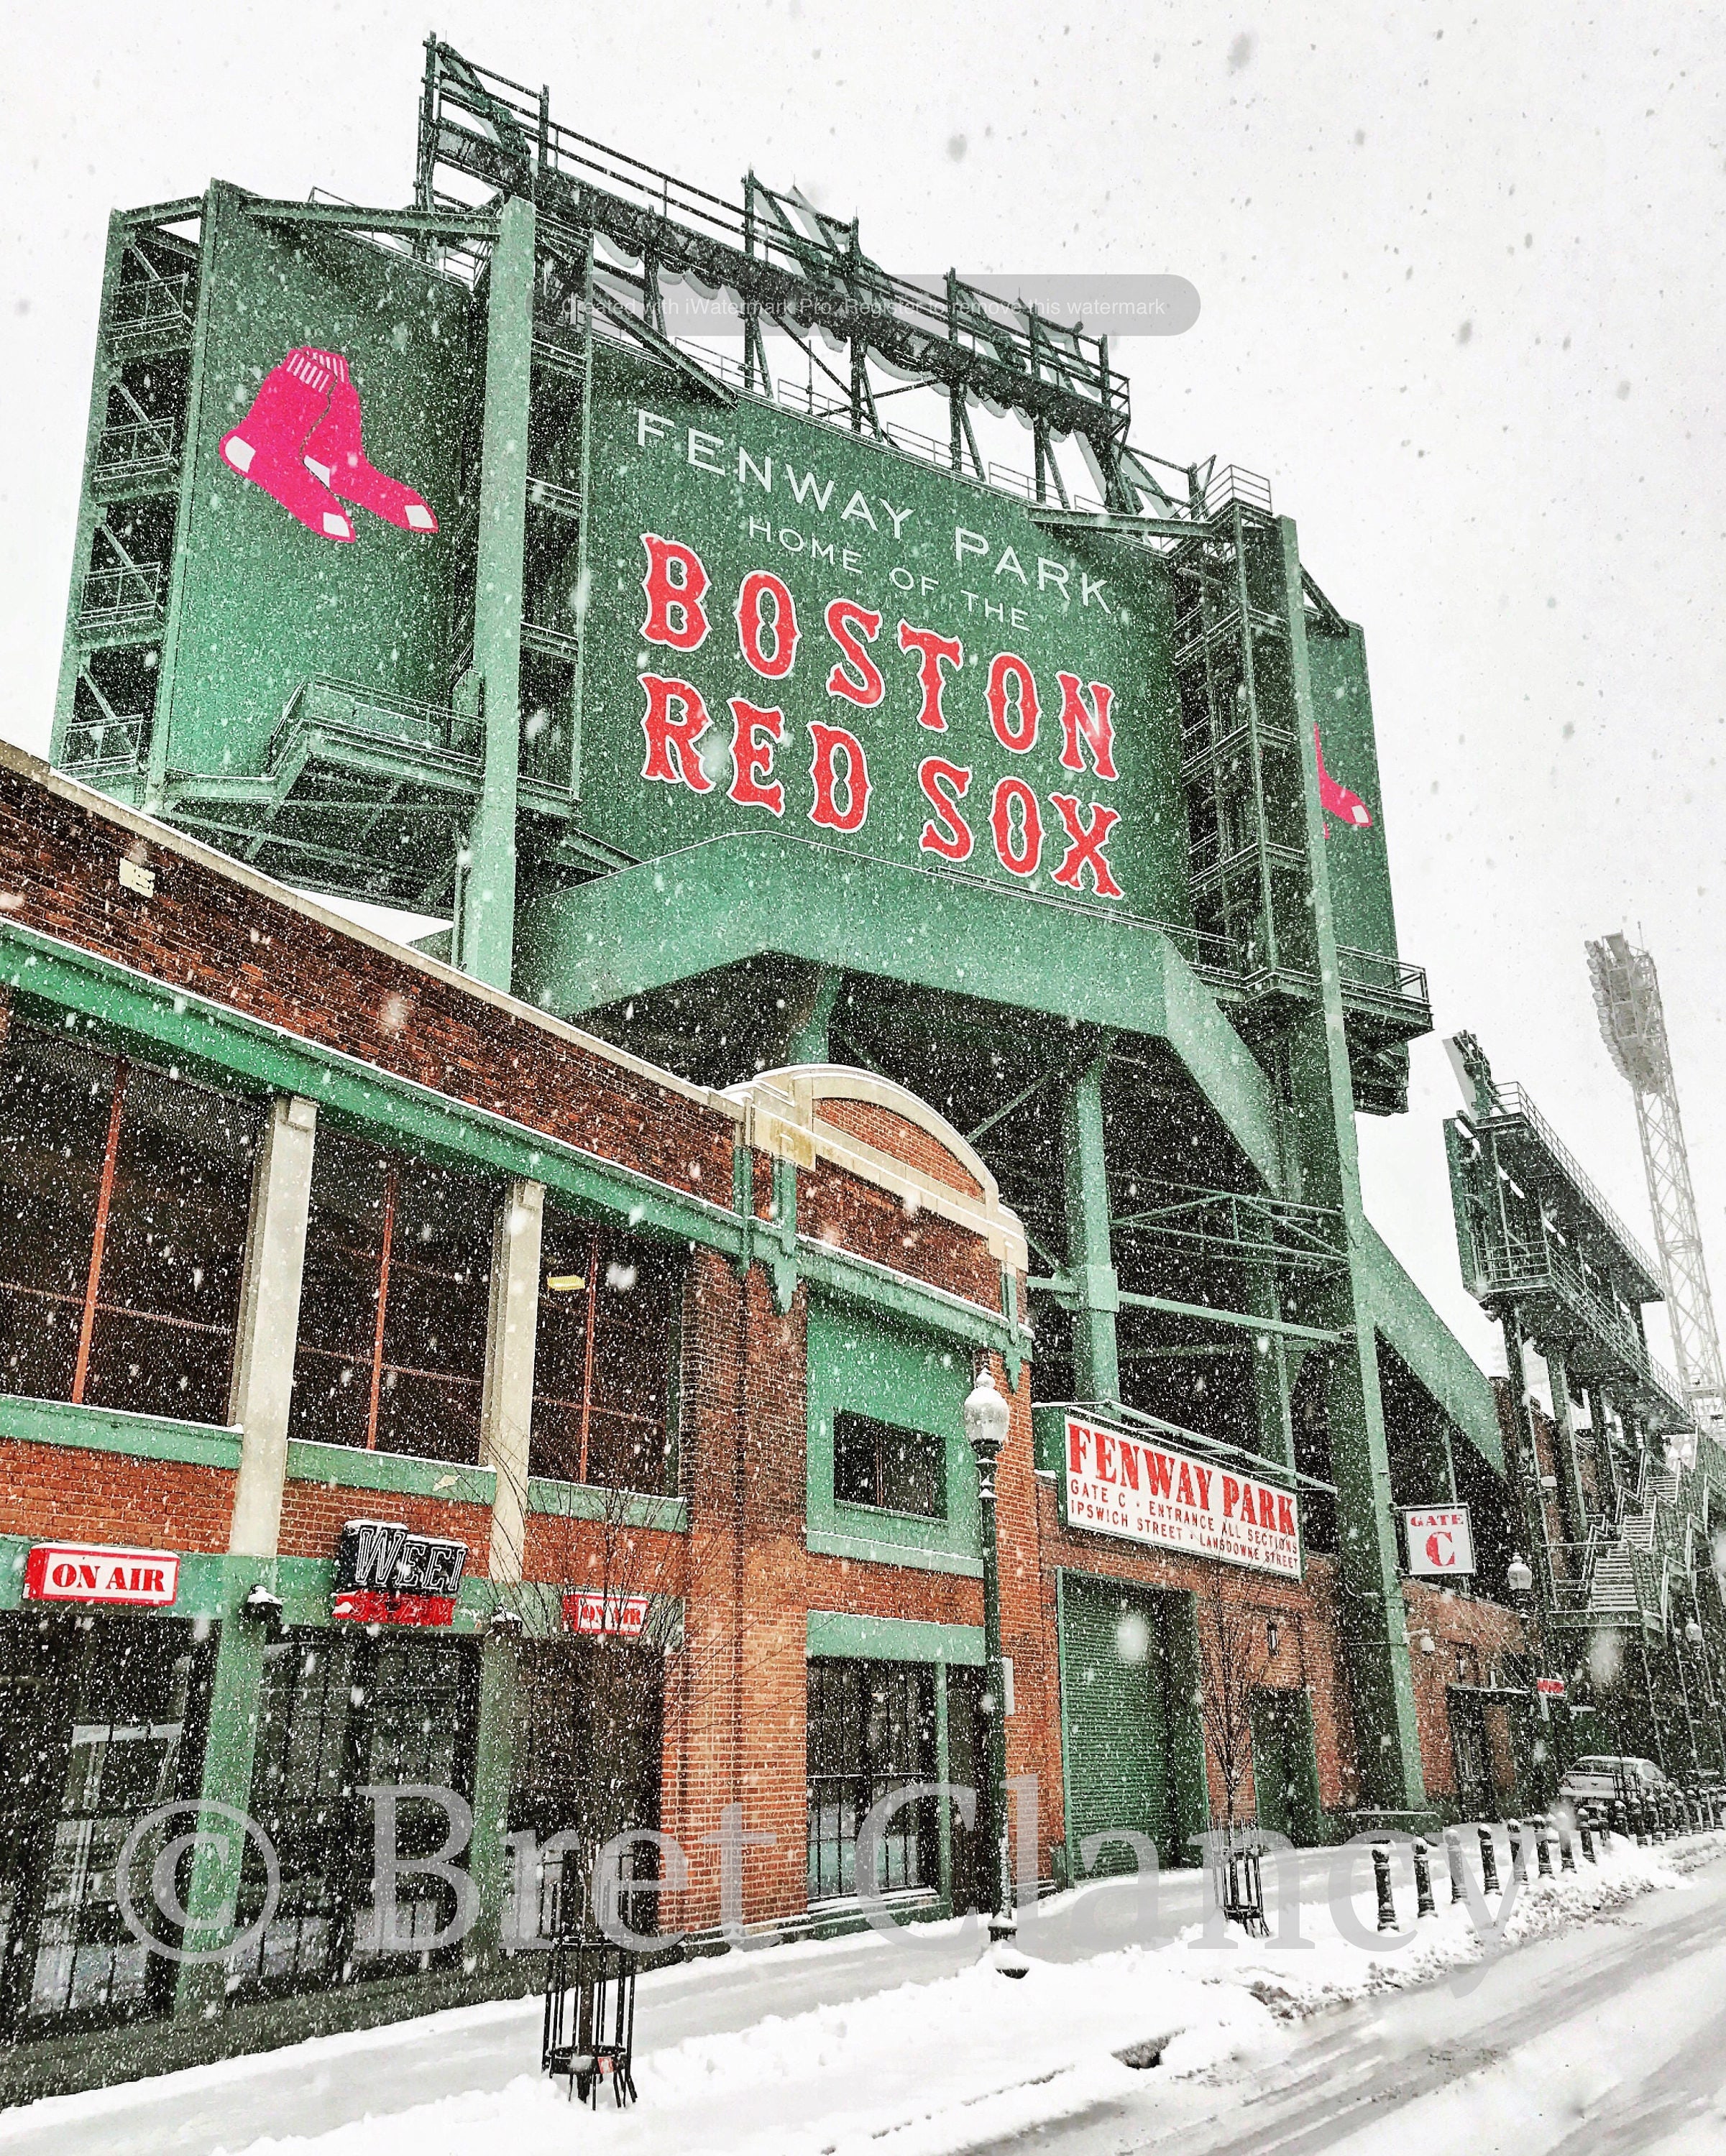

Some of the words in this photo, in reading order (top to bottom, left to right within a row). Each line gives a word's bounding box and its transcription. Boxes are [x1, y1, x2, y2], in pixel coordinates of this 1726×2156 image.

[637, 408, 914, 540] FENWAY
[955, 527, 1112, 615] PARK
[748, 515, 863, 574] HOME
[890, 566, 940, 597] OF
[960, 589, 1031, 632] THE
[638, 533, 1121, 782] BOSTON
[636, 672, 873, 834] RED
[917, 755, 1125, 901] SOX
[1068, 1422, 1213, 1511] FENWAY
[1222, 1474, 1296, 1537] PARK
[1070, 1478, 1108, 1503] GATE
[1119, 1491, 1126, 1510] C
[1149, 1500, 1215, 1532] ENTRANCE
[1221, 1517, 1241, 1539] ALL
[1247, 1528, 1298, 1554] SECTIONS
[1070, 1499, 1129, 1528] IPSWICH
[1137, 1516, 1183, 1541] STREET
[1200, 1531, 1259, 1560] LANSDOWNE
[1264, 1550, 1298, 1570] STREET
[1410, 1513, 1464, 1528] GATE
[1425, 1531, 1456, 1567] C
[52, 1563, 101, 1589] ON
[106, 1567, 165, 1593] AIR
[354, 1527, 467, 1591] WEEI
